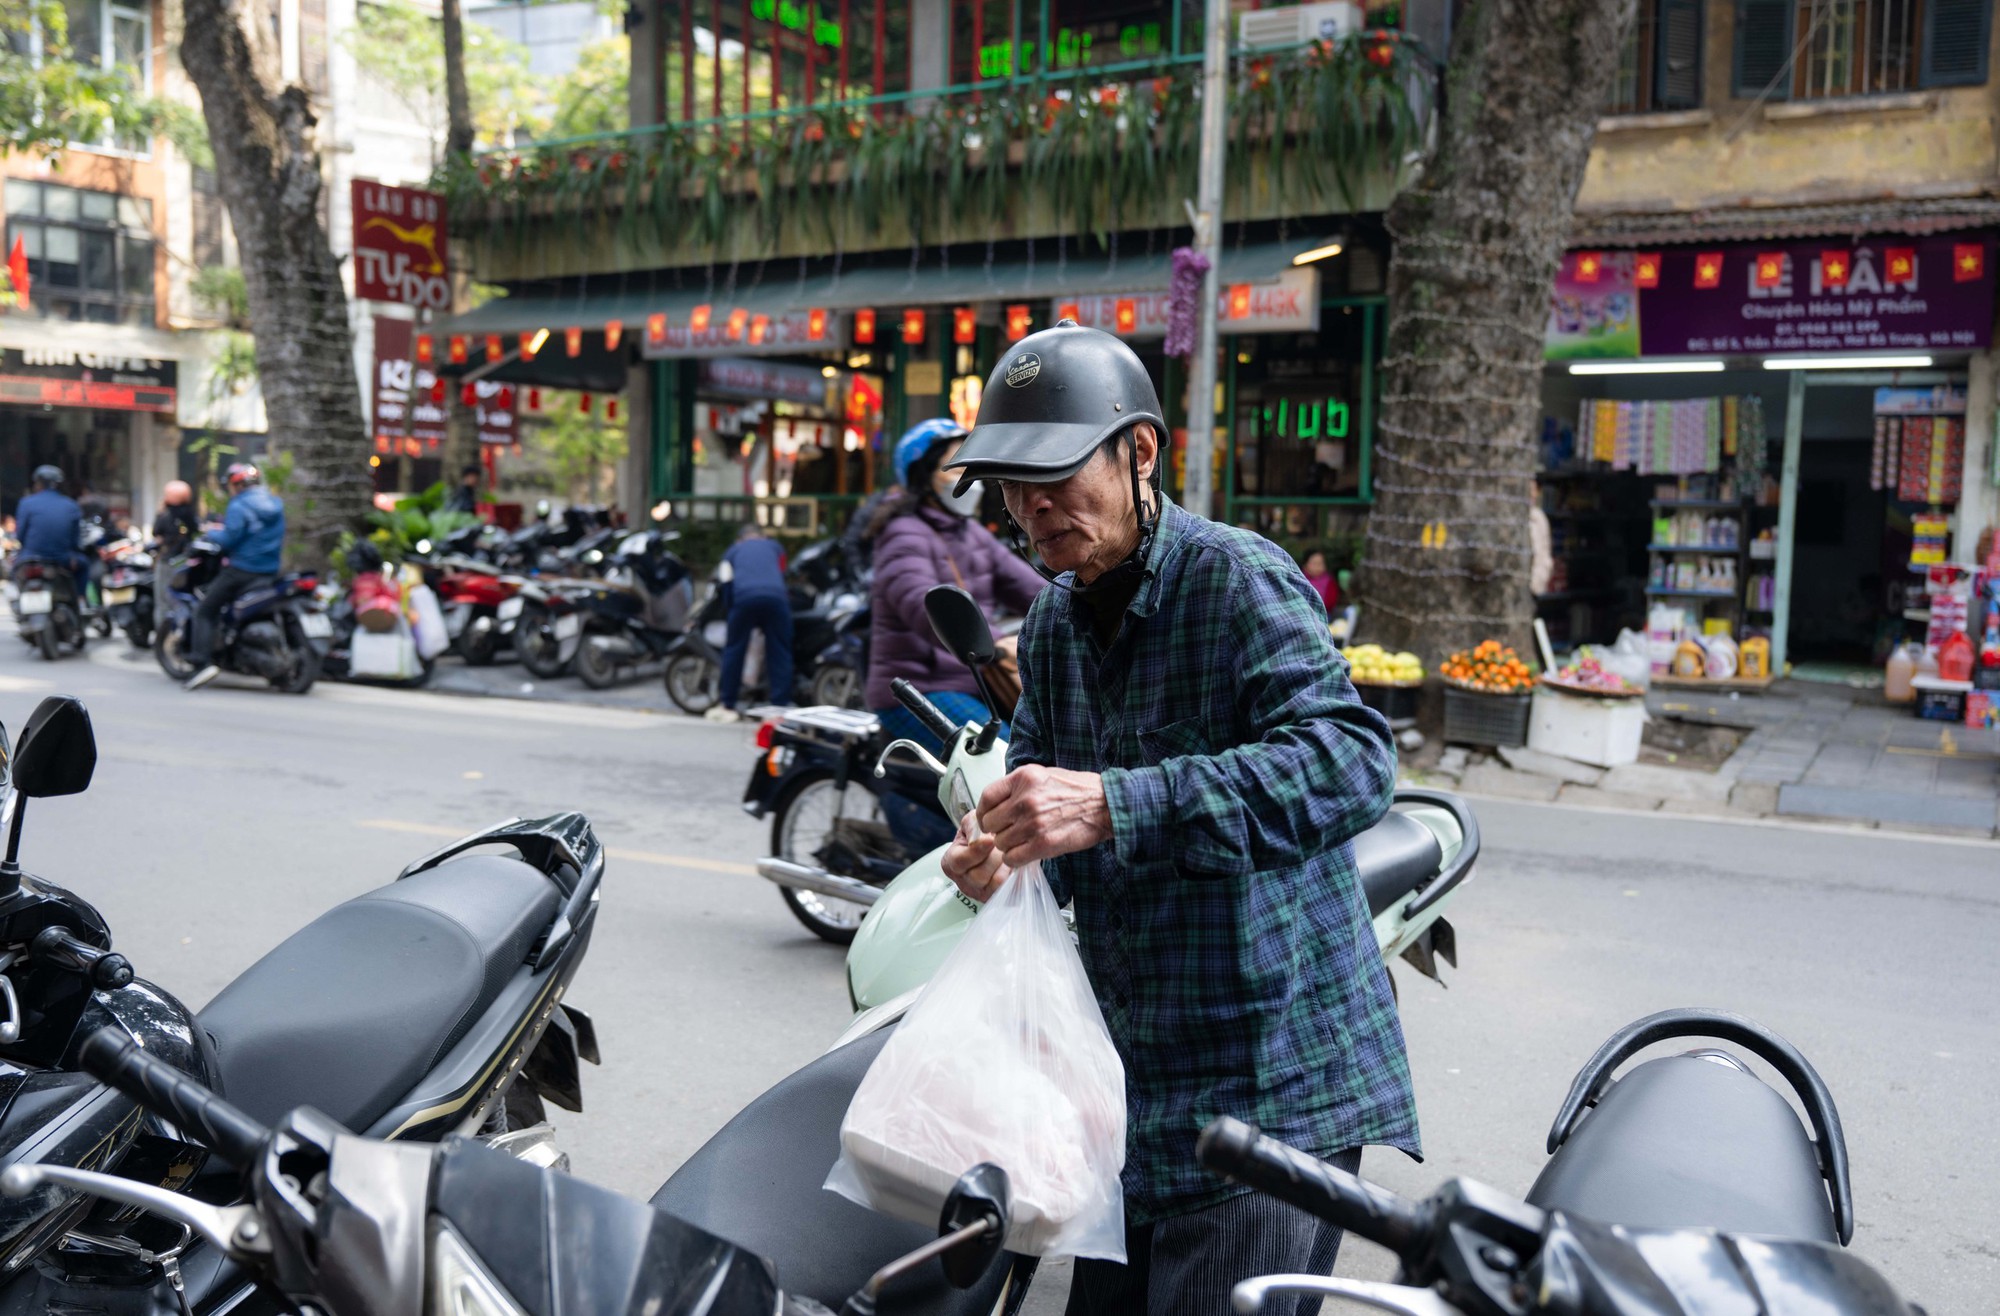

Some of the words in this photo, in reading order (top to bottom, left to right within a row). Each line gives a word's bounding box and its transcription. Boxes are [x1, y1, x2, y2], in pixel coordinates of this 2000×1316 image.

[1810, 247, 1918, 297] HÂ
[403, 270, 450, 307] DO
[1741, 302, 1805, 321] Chuyên
[1010, 367, 1037, 384] SERVIZIO
